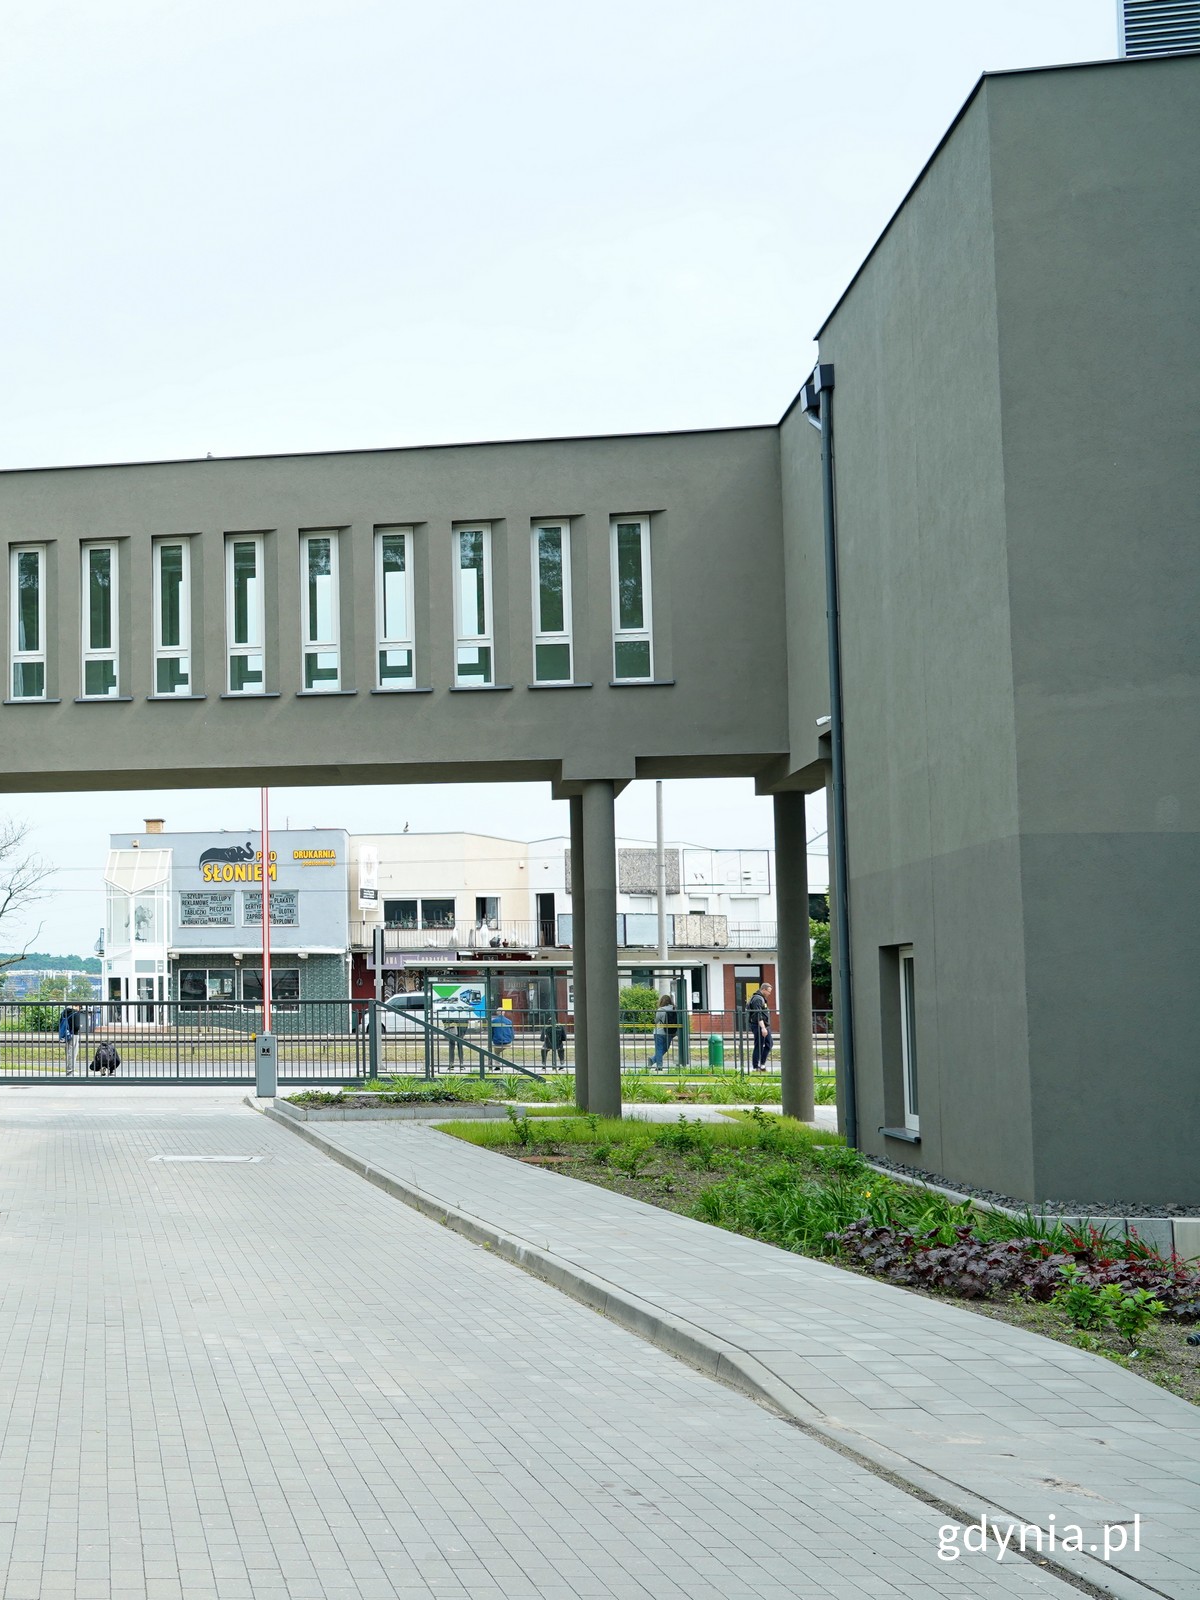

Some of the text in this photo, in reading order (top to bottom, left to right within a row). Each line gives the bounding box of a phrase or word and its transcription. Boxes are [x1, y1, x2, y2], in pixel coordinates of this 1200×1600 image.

[256, 851, 277, 862] PD
[293, 849, 336, 859] DRUKARNIA
[203, 863, 277, 882] SŁONIEM
